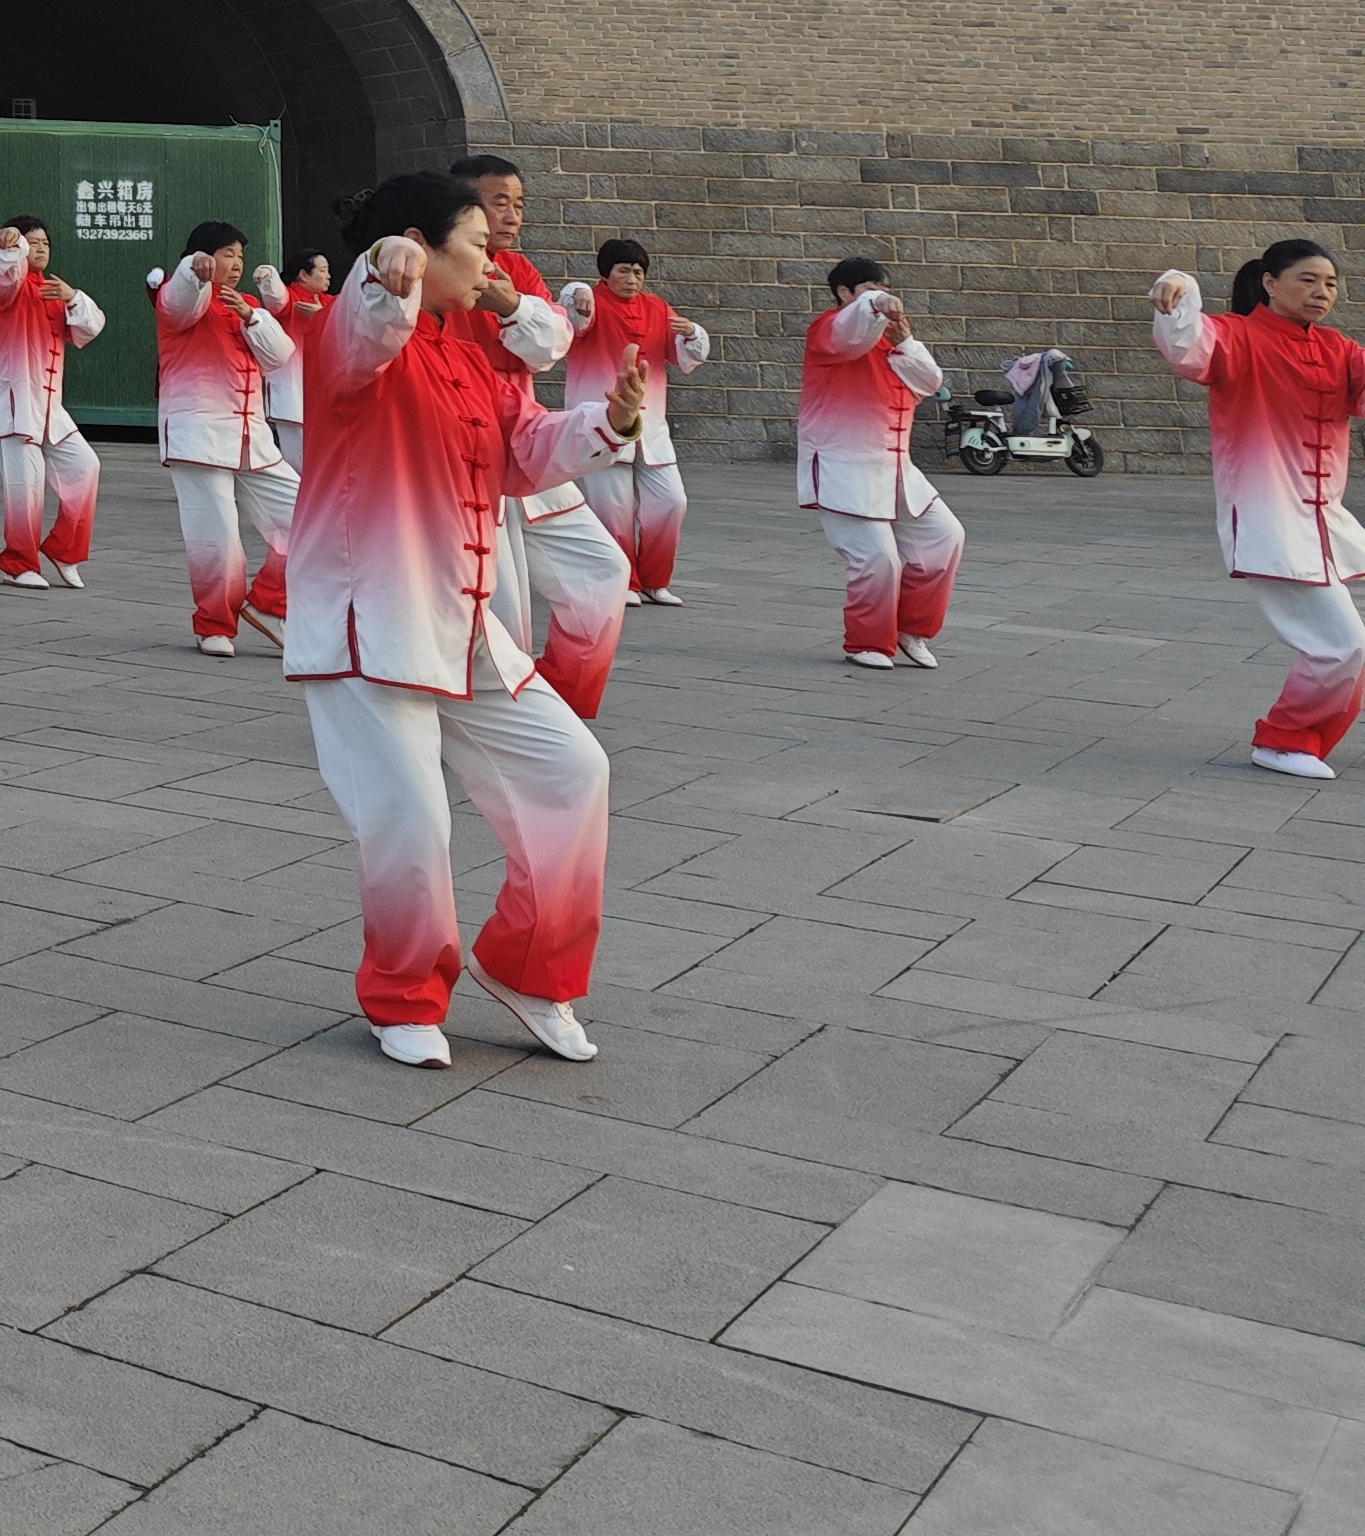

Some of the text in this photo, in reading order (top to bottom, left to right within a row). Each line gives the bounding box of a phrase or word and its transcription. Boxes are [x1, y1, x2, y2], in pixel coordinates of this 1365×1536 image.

[76, 179, 153, 200] 鑫兴箱房
[76, 214, 153, 228] 随车吊出租
[76, 229, 153, 240] 13273923661
